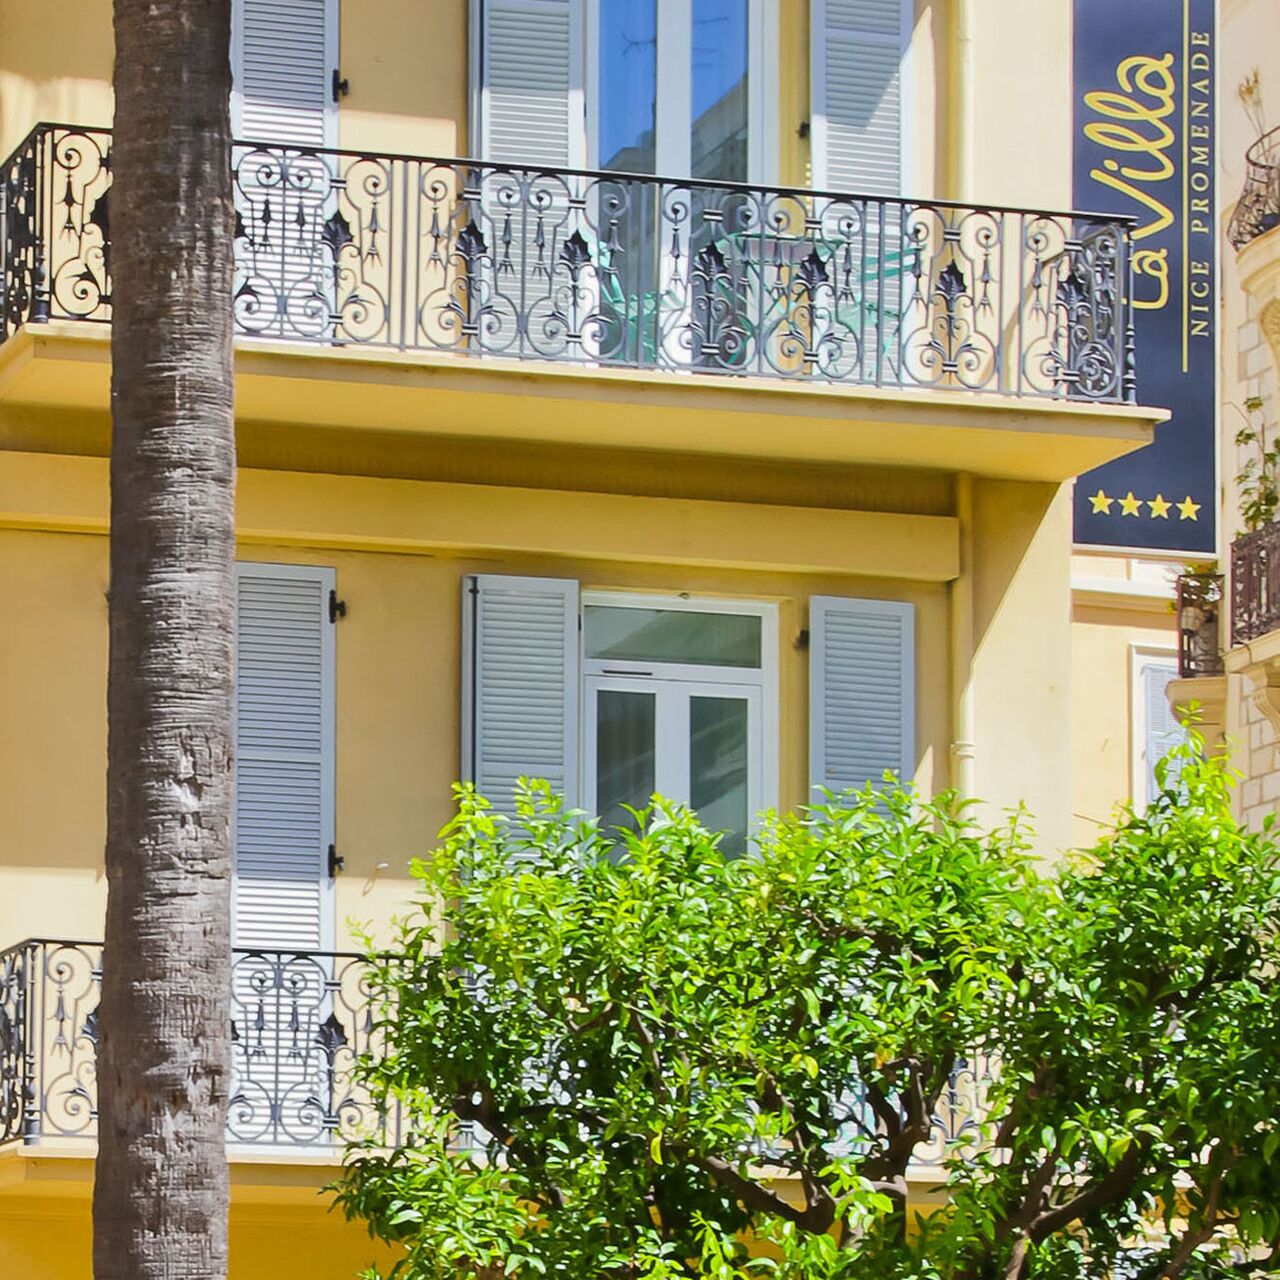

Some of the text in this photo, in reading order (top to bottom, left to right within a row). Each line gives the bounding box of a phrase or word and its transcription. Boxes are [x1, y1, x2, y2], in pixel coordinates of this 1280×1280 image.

[1083, 52, 1175, 310] La Villa
[1190, 31, 1210, 337] NICE PROMENADE
